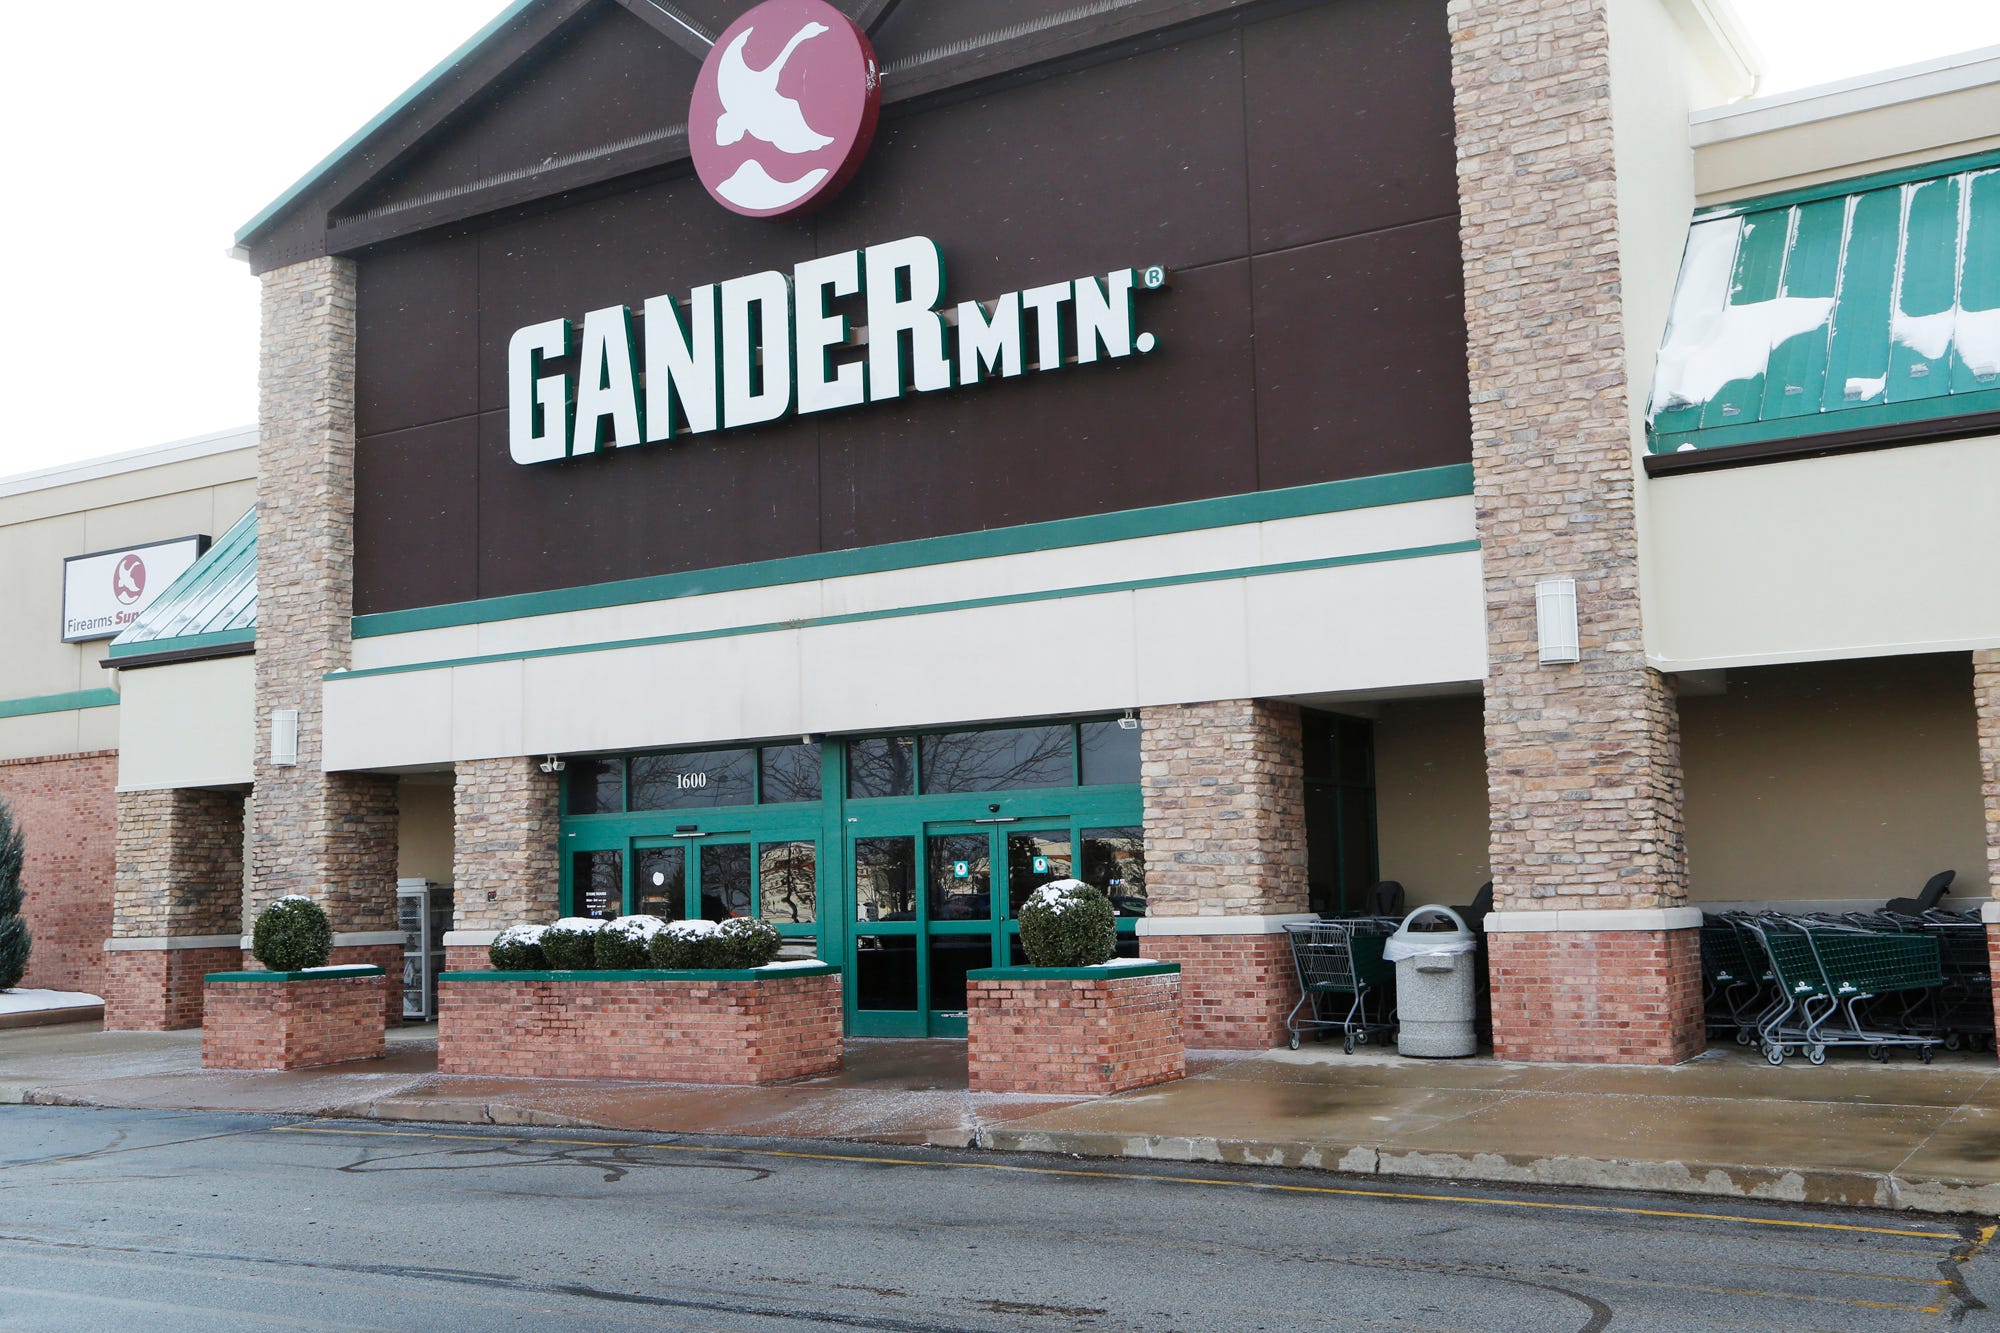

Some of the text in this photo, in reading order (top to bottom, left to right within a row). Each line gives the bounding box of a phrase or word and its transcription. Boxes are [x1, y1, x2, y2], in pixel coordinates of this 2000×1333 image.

[508, 235, 954, 466] GANDER
[68, 616, 112, 632] Firearms
[676, 772, 707, 789] 1600
